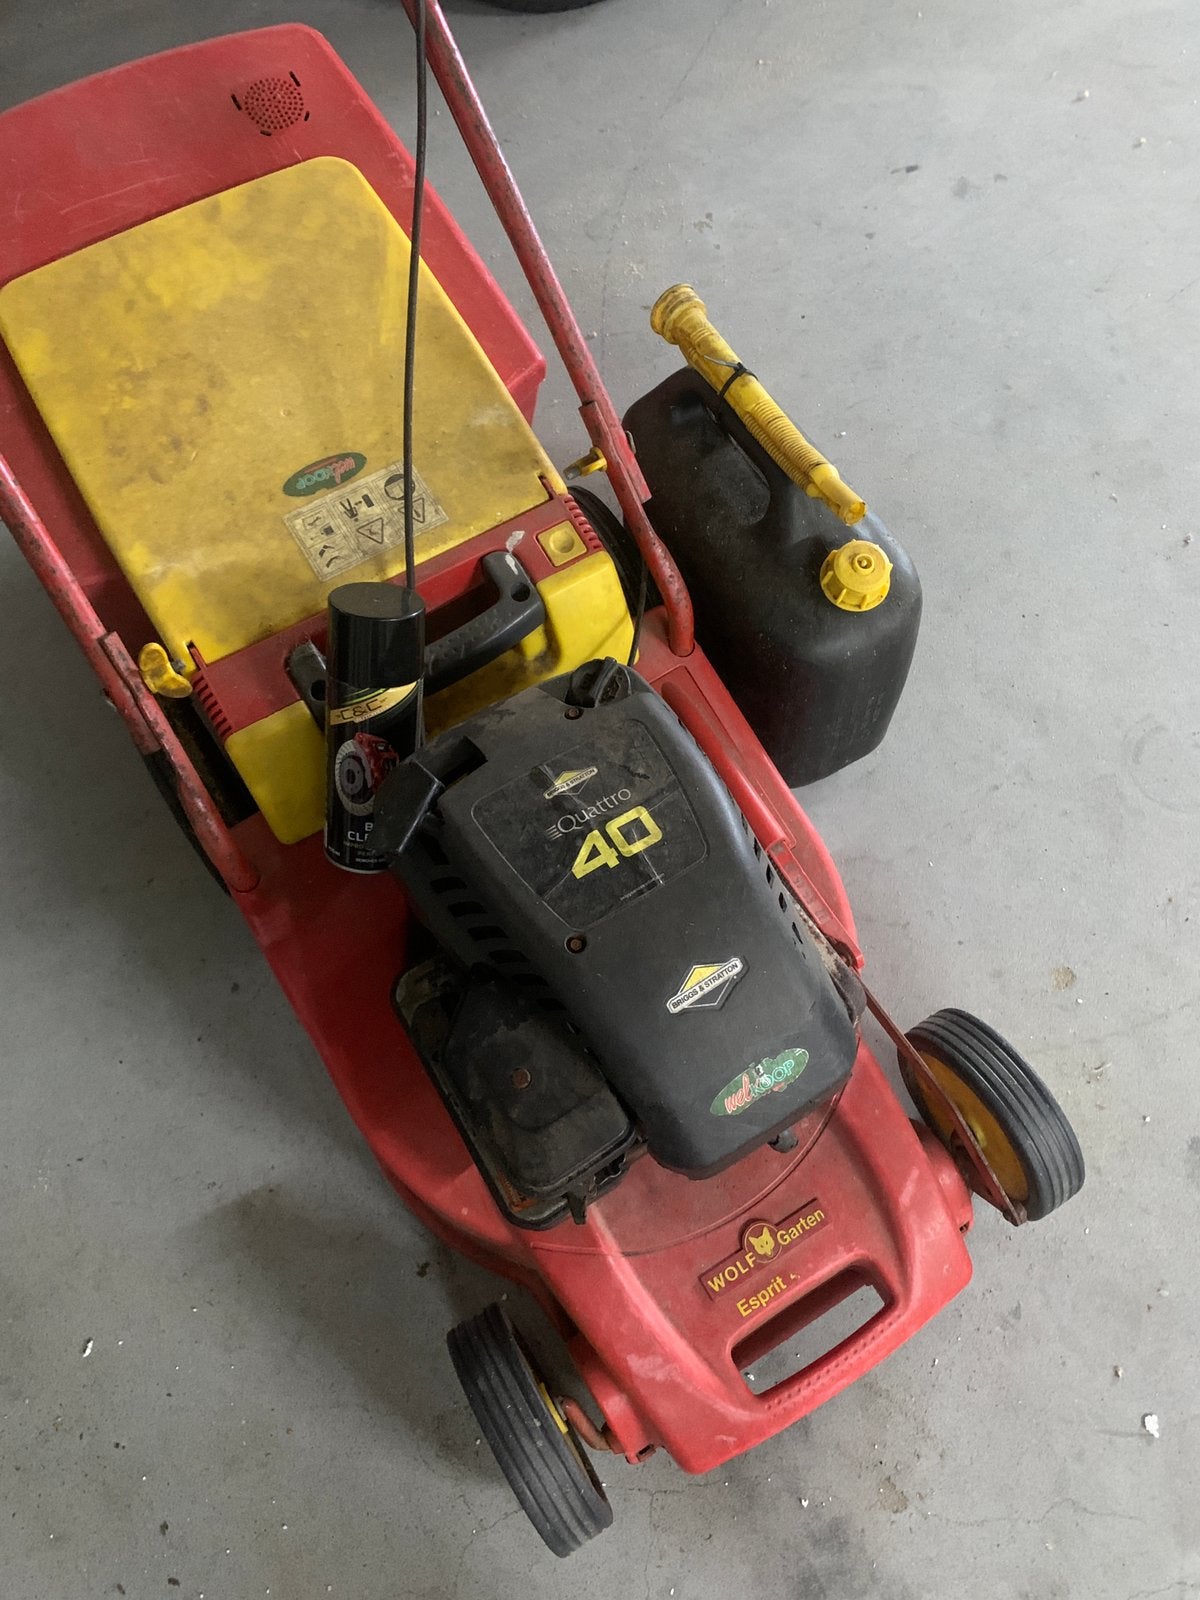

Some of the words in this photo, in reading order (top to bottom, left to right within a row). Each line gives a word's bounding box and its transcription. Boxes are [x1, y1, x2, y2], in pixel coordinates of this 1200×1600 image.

[340, 698, 382, 720] C&C
[557, 788, 631, 833] Quattro
[571, 805, 663, 880] 40
[671, 988, 698, 1010] BRIGGS
[704, 962, 739, 988] STRATTON
[707, 1252, 757, 1292] WOLF
[776, 1209, 825, 1246] Garten
[736, 1276, 788, 1317] Esprit
